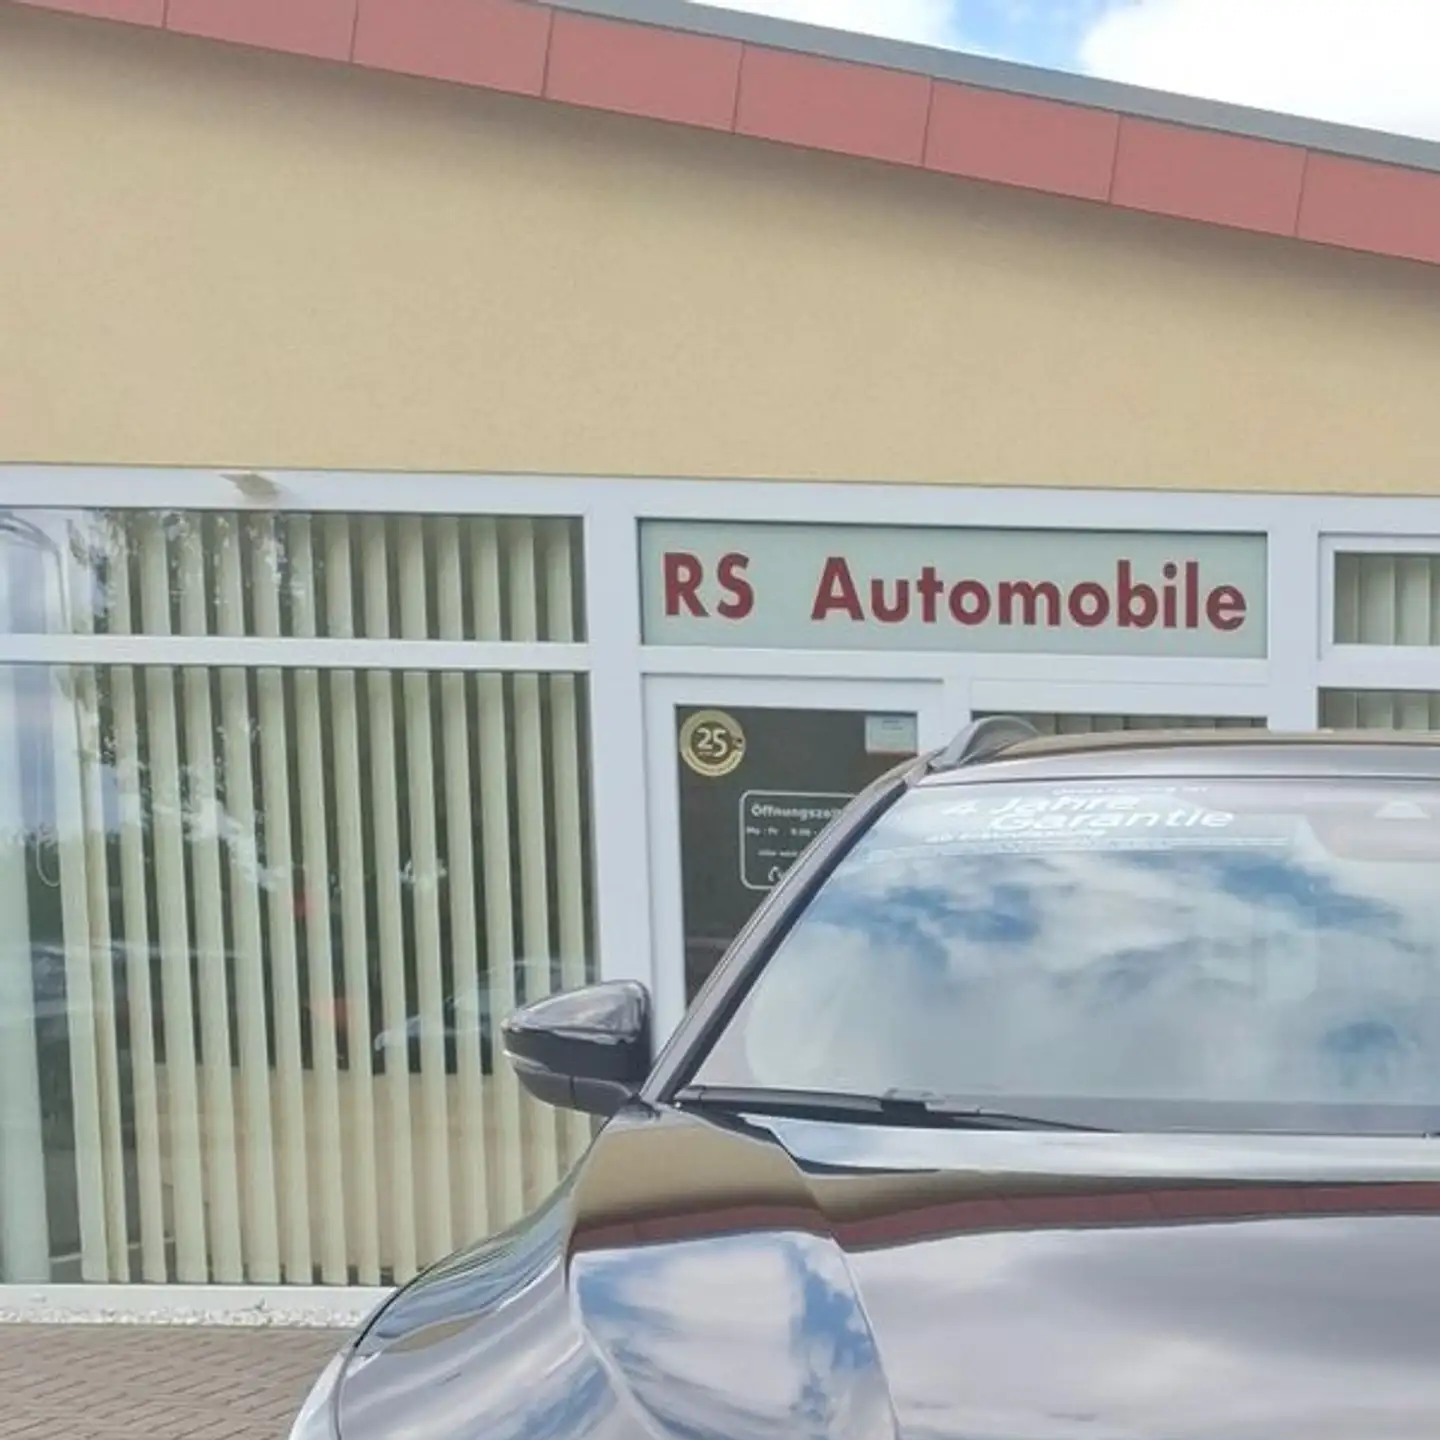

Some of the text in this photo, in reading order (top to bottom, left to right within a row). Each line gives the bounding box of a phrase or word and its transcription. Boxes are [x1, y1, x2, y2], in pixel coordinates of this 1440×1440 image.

[664, 552, 1247, 630] RS Automobile
[696, 727, 728, 757] 25
[987, 808, 1235, 831] Garantie
